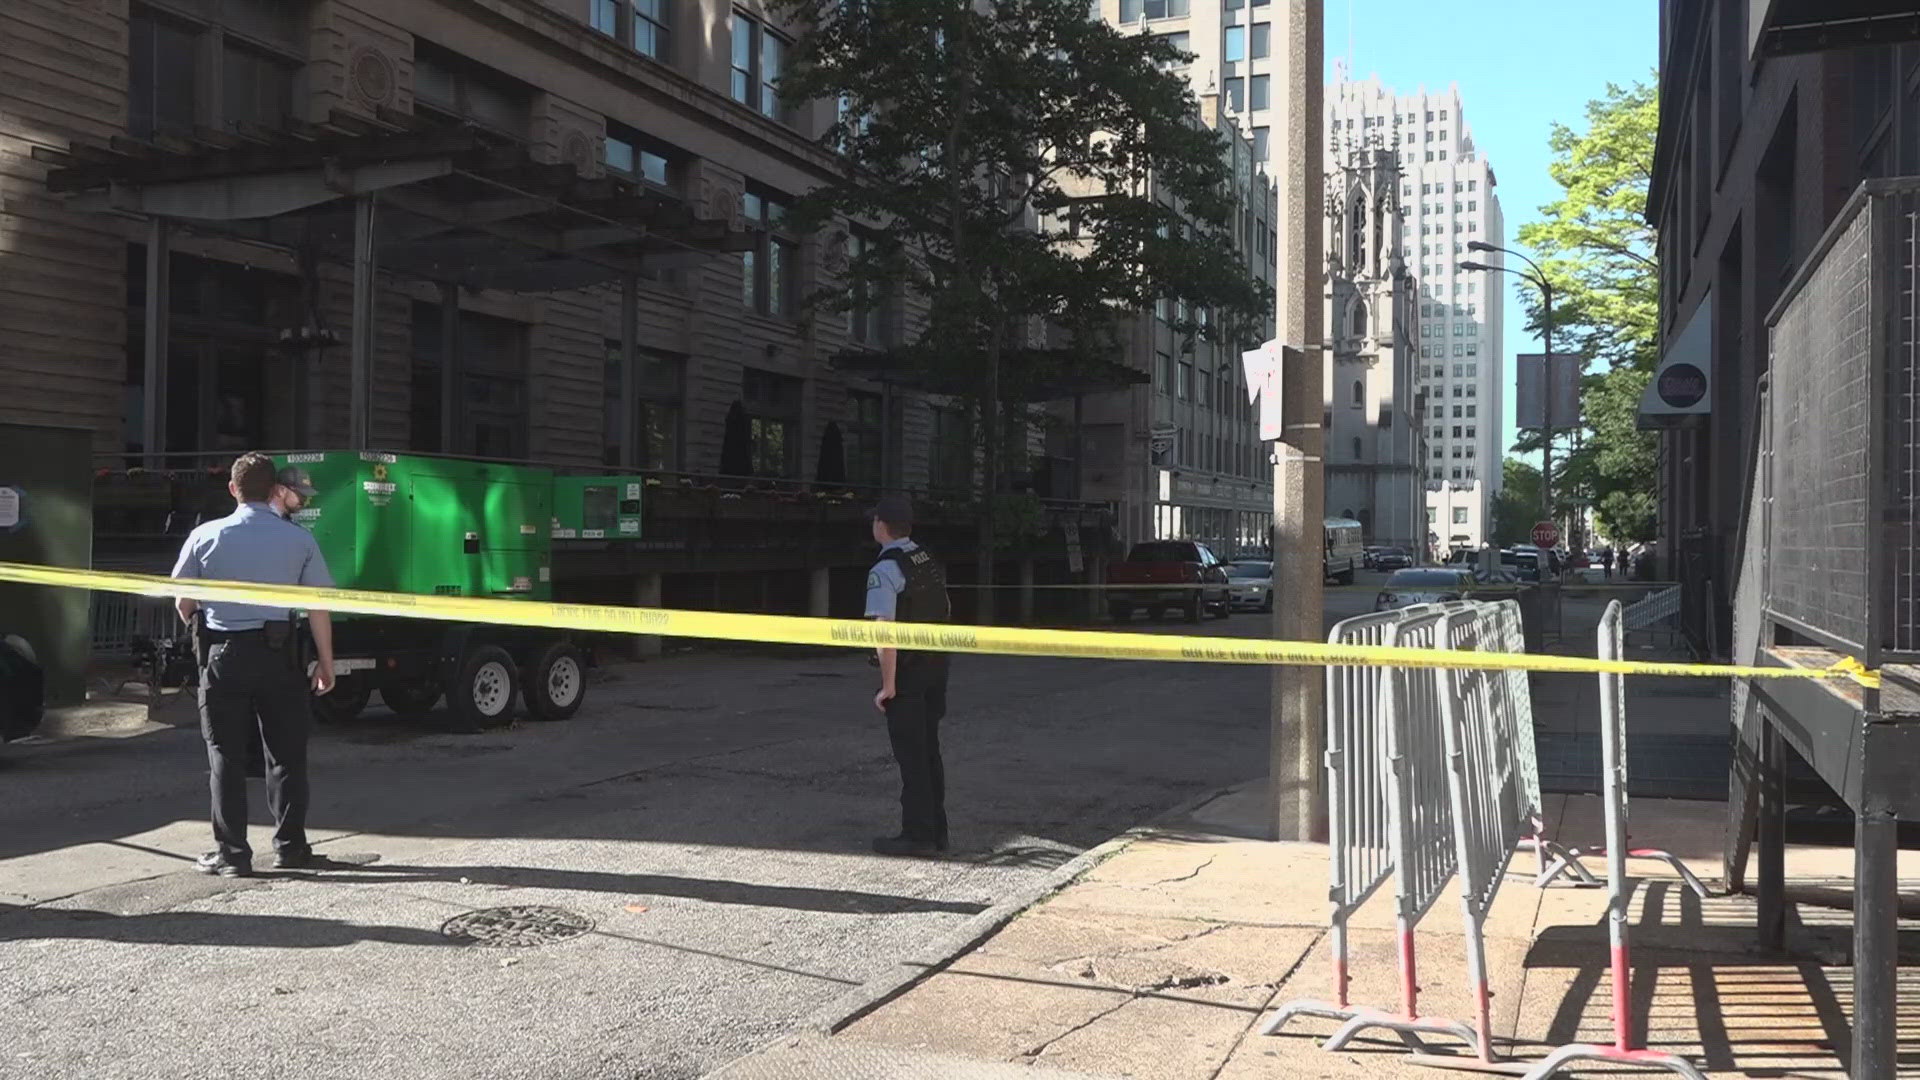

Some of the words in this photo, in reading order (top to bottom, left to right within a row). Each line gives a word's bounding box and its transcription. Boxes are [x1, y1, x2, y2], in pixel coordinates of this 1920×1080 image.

[363, 481, 396, 491] SUNBELT
[1532, 529, 1558, 541] STOP
[910, 551, 930, 566] POLICE
[896, 629, 911, 645] DO
[914, 630, 937, 647] NOT
[940, 631, 977, 648] CROSS
